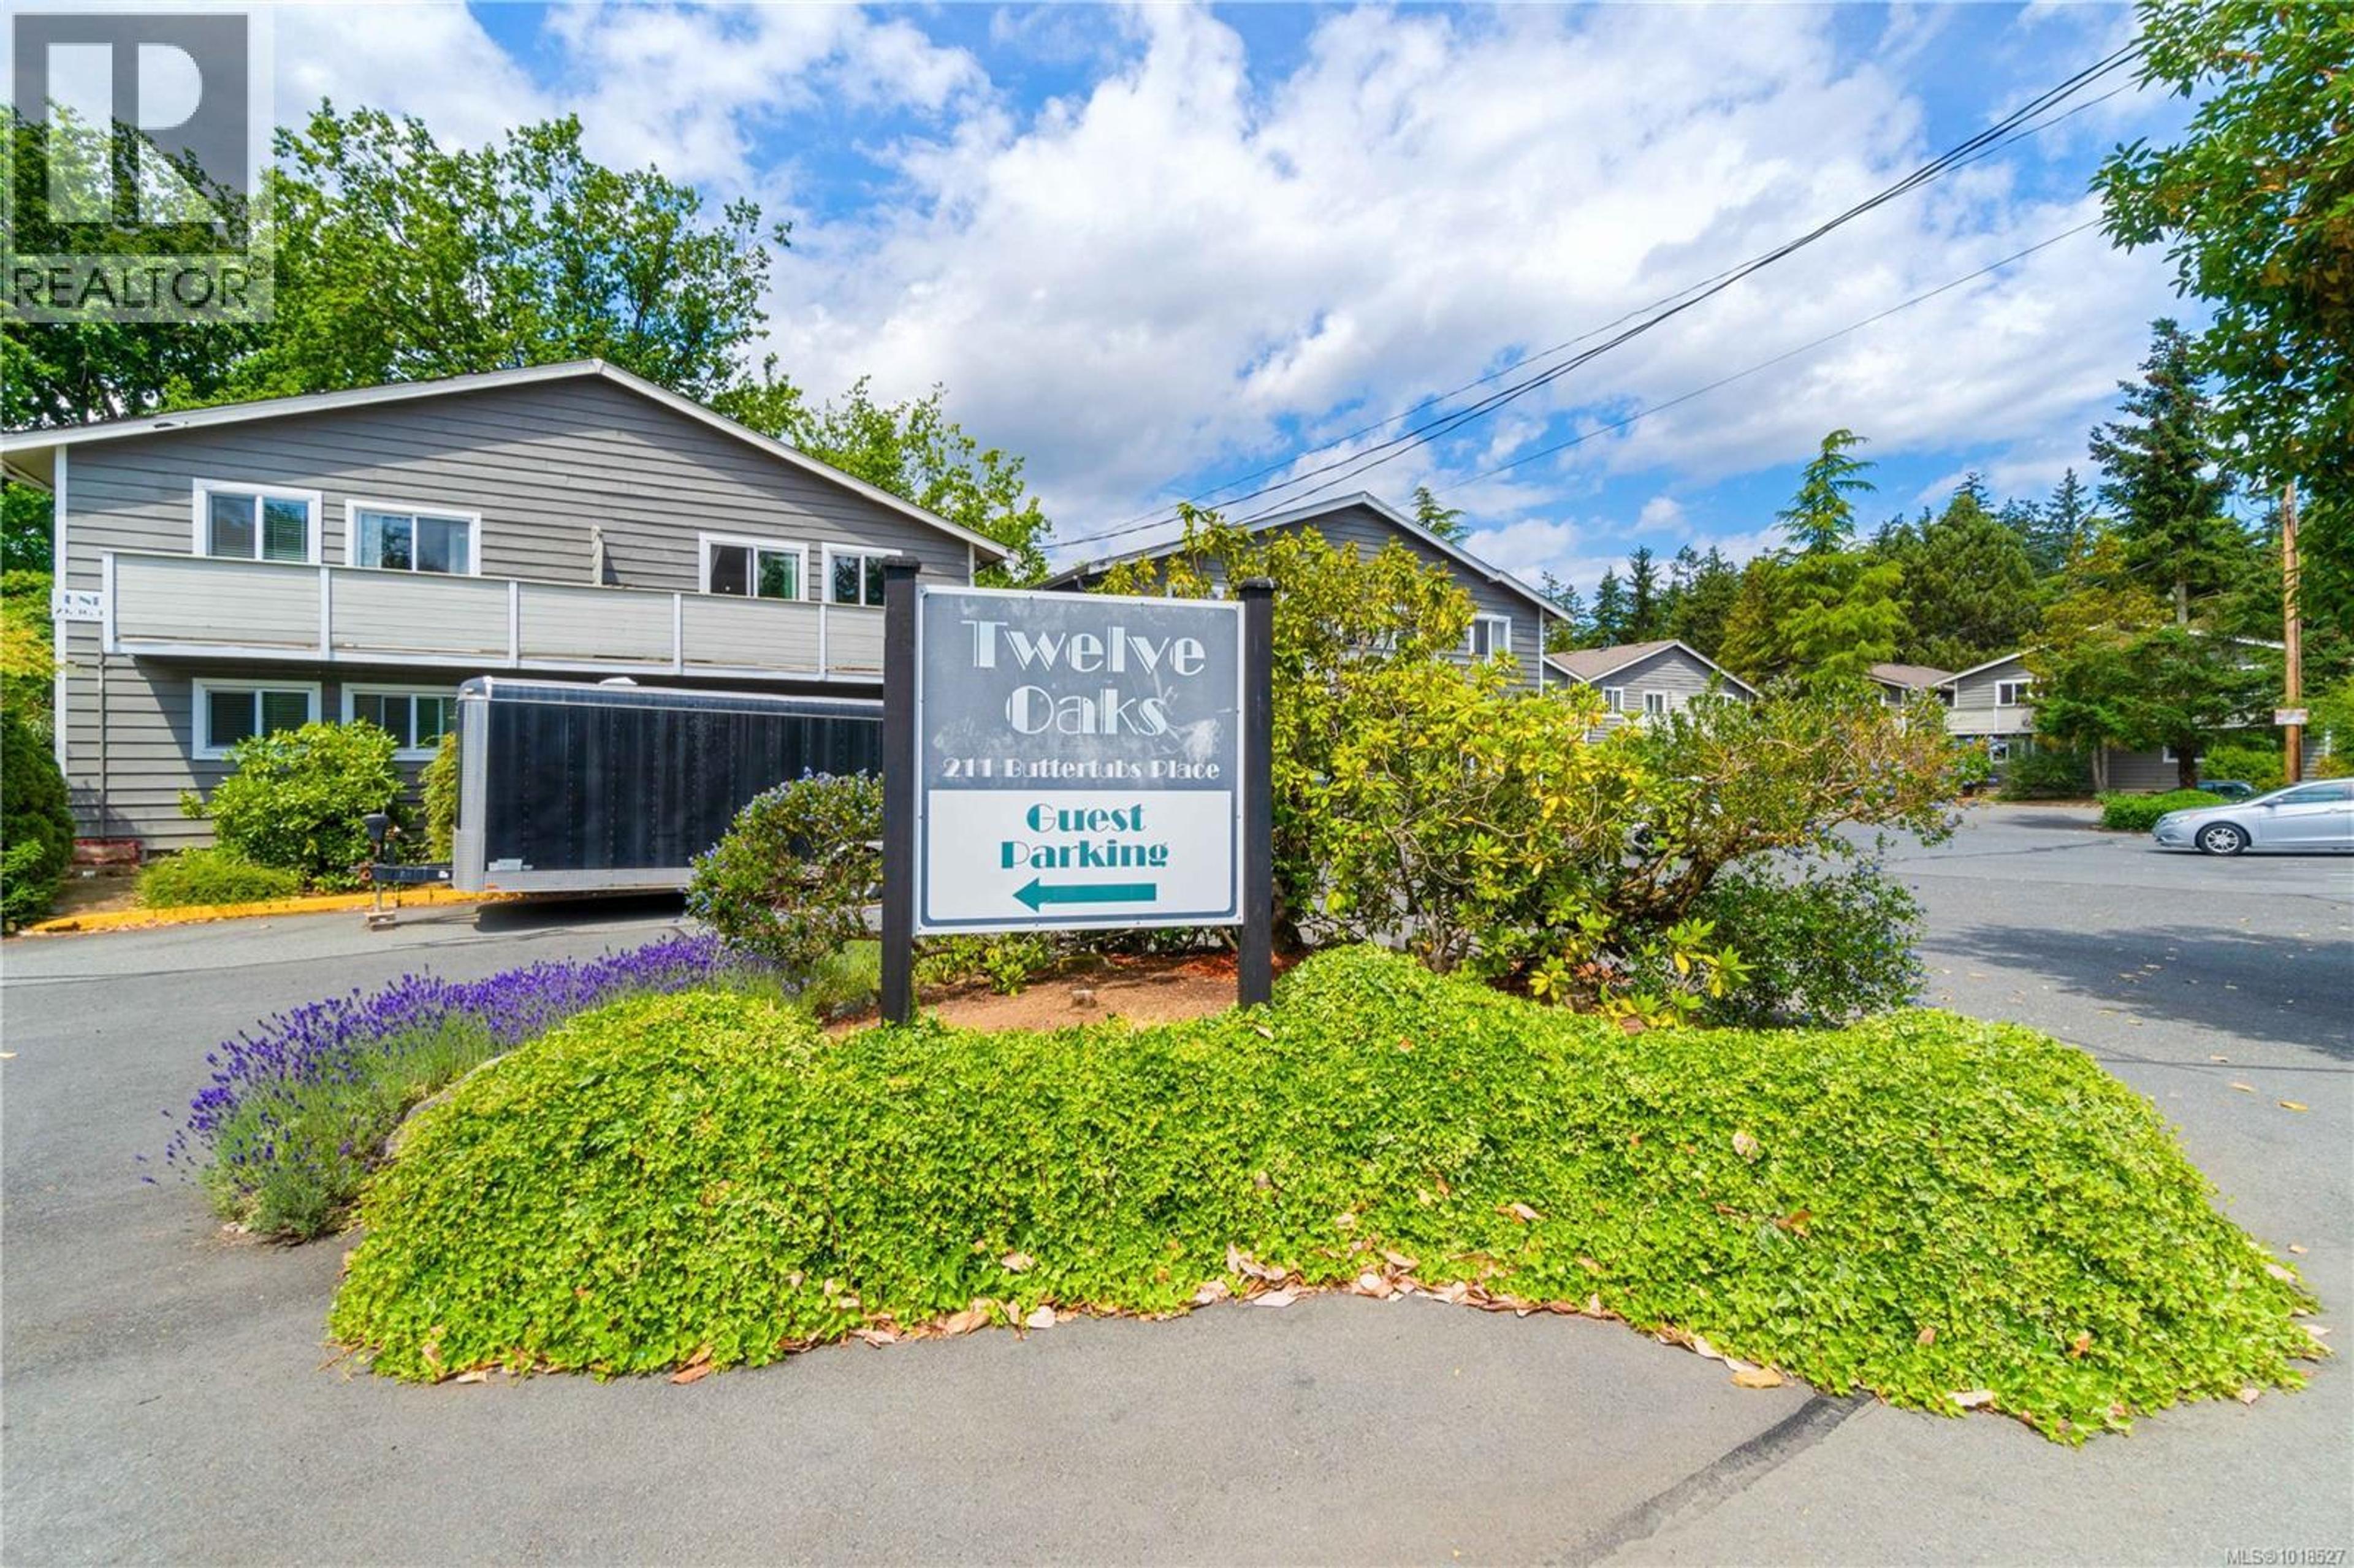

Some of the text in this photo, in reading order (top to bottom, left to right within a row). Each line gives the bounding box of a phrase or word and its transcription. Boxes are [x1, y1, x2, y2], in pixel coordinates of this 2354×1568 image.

[961, 619, 1206, 677] Twelve
[1005, 685, 1169, 737] Oaks
[942, 758, 1221, 780] 211 Buttertubs Place
[1026, 803, 1147, 832] Guest
[1000, 840, 1169, 869] Parking
